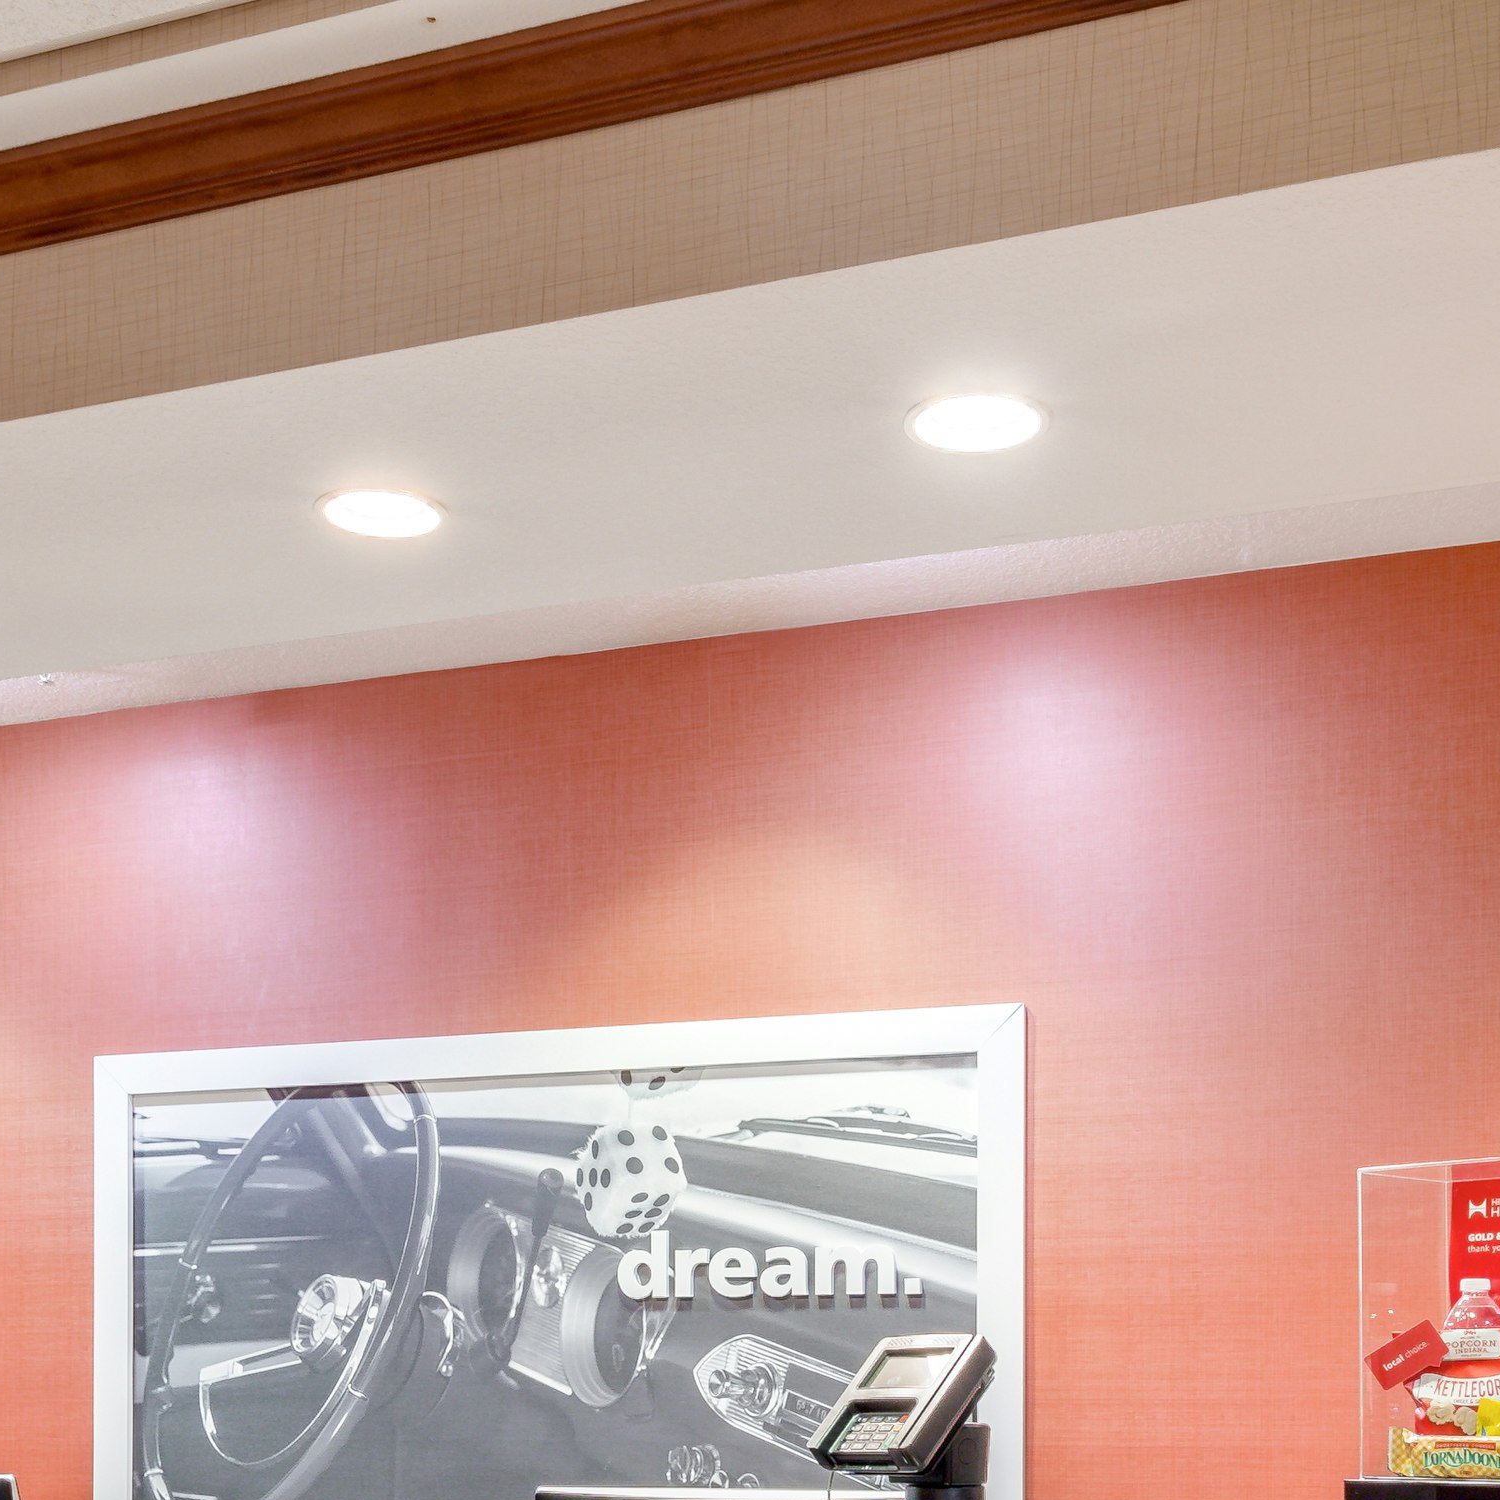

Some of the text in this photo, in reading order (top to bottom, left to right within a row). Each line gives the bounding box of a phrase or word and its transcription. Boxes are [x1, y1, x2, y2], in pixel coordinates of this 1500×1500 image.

[1468, 1232, 1494, 1242] GOLD
[1467, 1244, 1490, 1254] thank
[616, 1229, 924, 1300] dream.
[1382, 1354, 1405, 1372] local
